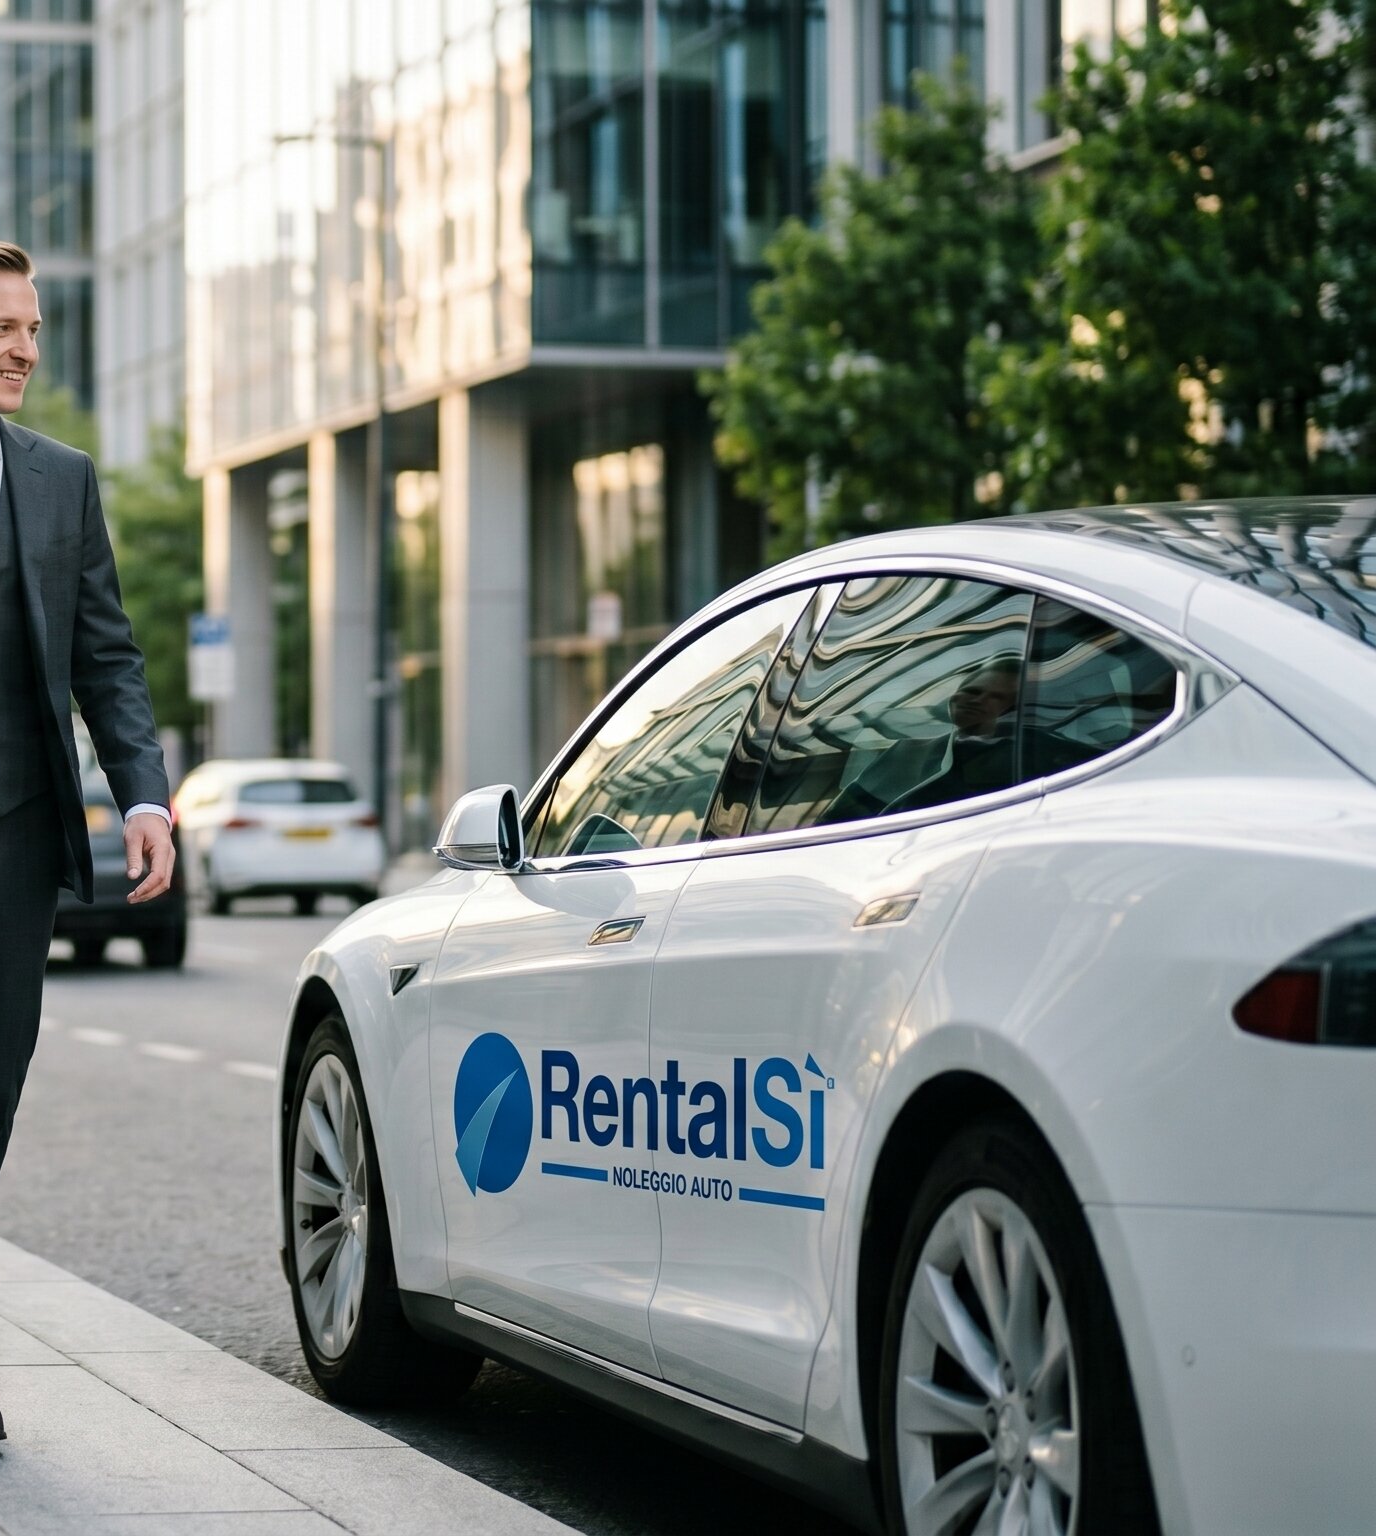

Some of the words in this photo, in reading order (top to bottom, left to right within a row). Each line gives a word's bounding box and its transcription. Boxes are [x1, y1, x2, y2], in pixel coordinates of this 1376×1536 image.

[541, 1050, 825, 1170] RentalSì
[613, 1166, 687, 1196] NOLEGGIO
[690, 1176, 733, 1202] AUTO
